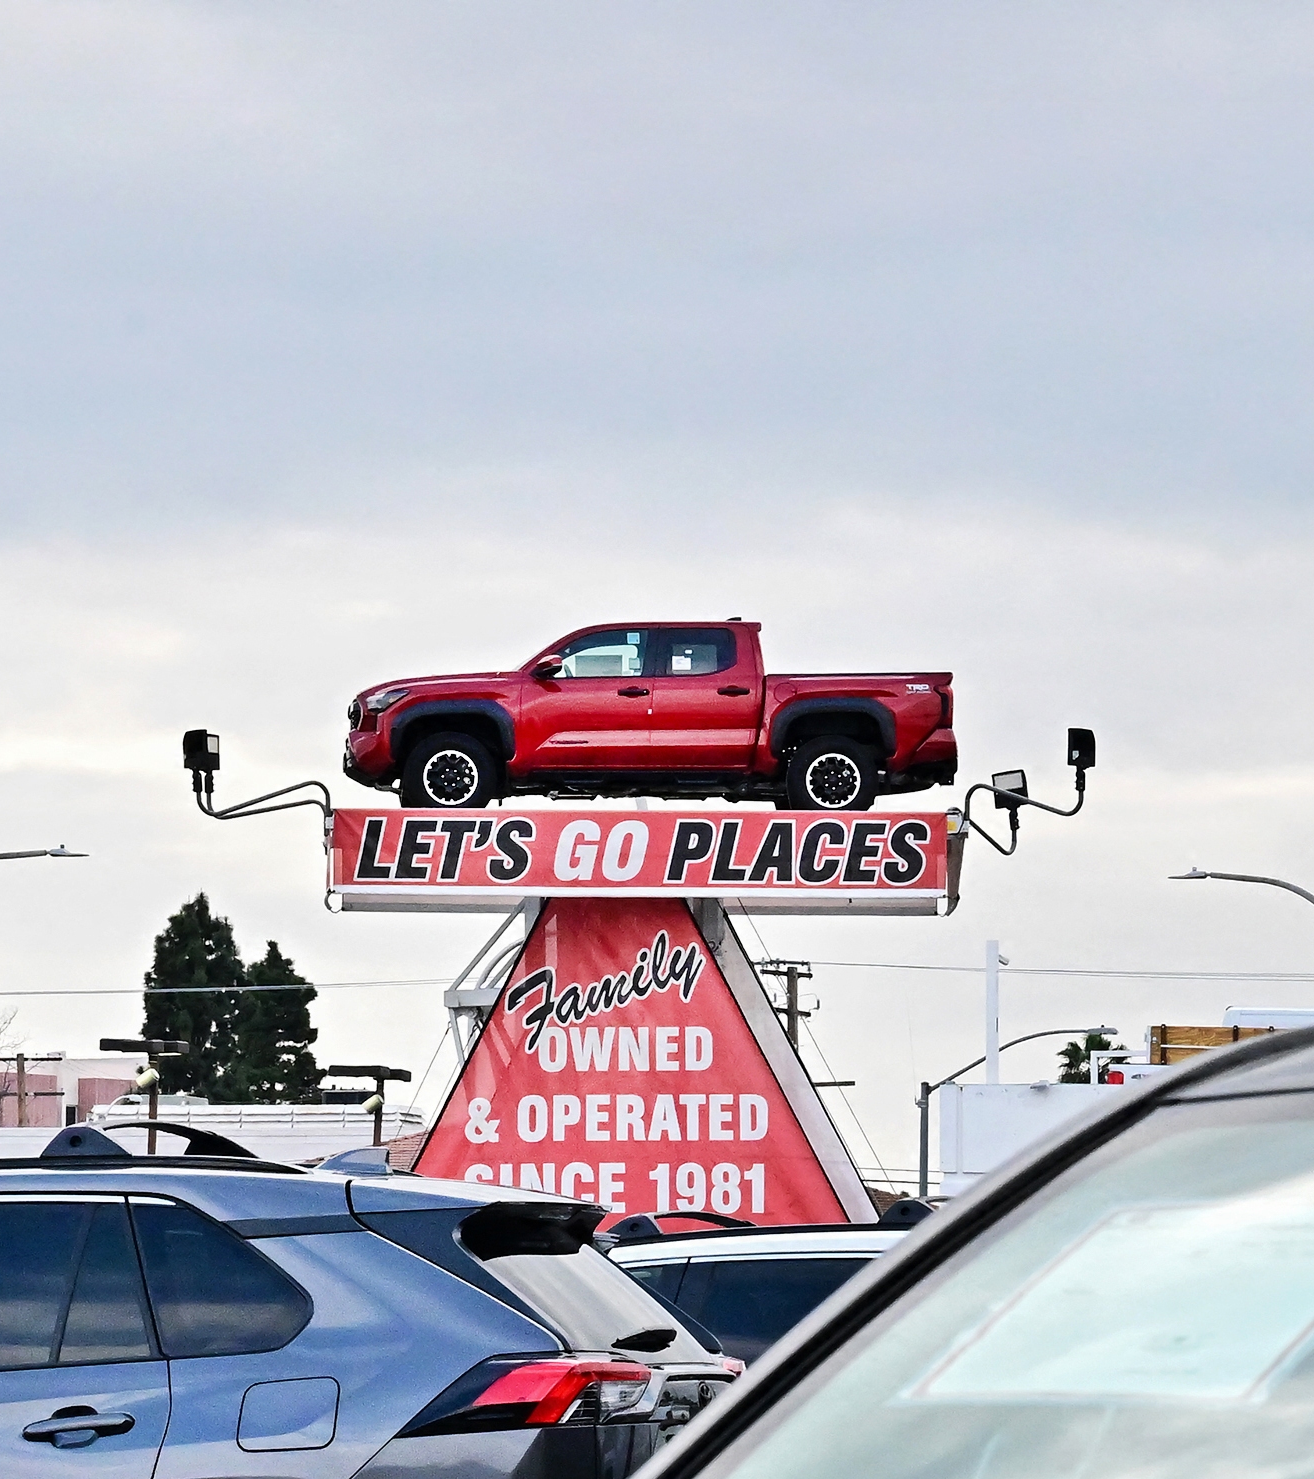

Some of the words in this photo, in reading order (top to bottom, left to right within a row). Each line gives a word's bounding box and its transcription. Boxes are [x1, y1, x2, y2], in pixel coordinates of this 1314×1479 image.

[354, 817, 534, 883] LET'S
[555, 820, 650, 882] GO
[664, 818, 930, 884] PLACES
[505, 930, 706, 1053] Family
[539, 1026, 713, 1073] OWNED
[464, 1097, 501, 1144] &
[517, 1094, 769, 1142] OPERATED
[649, 1162, 766, 1214] 1981
